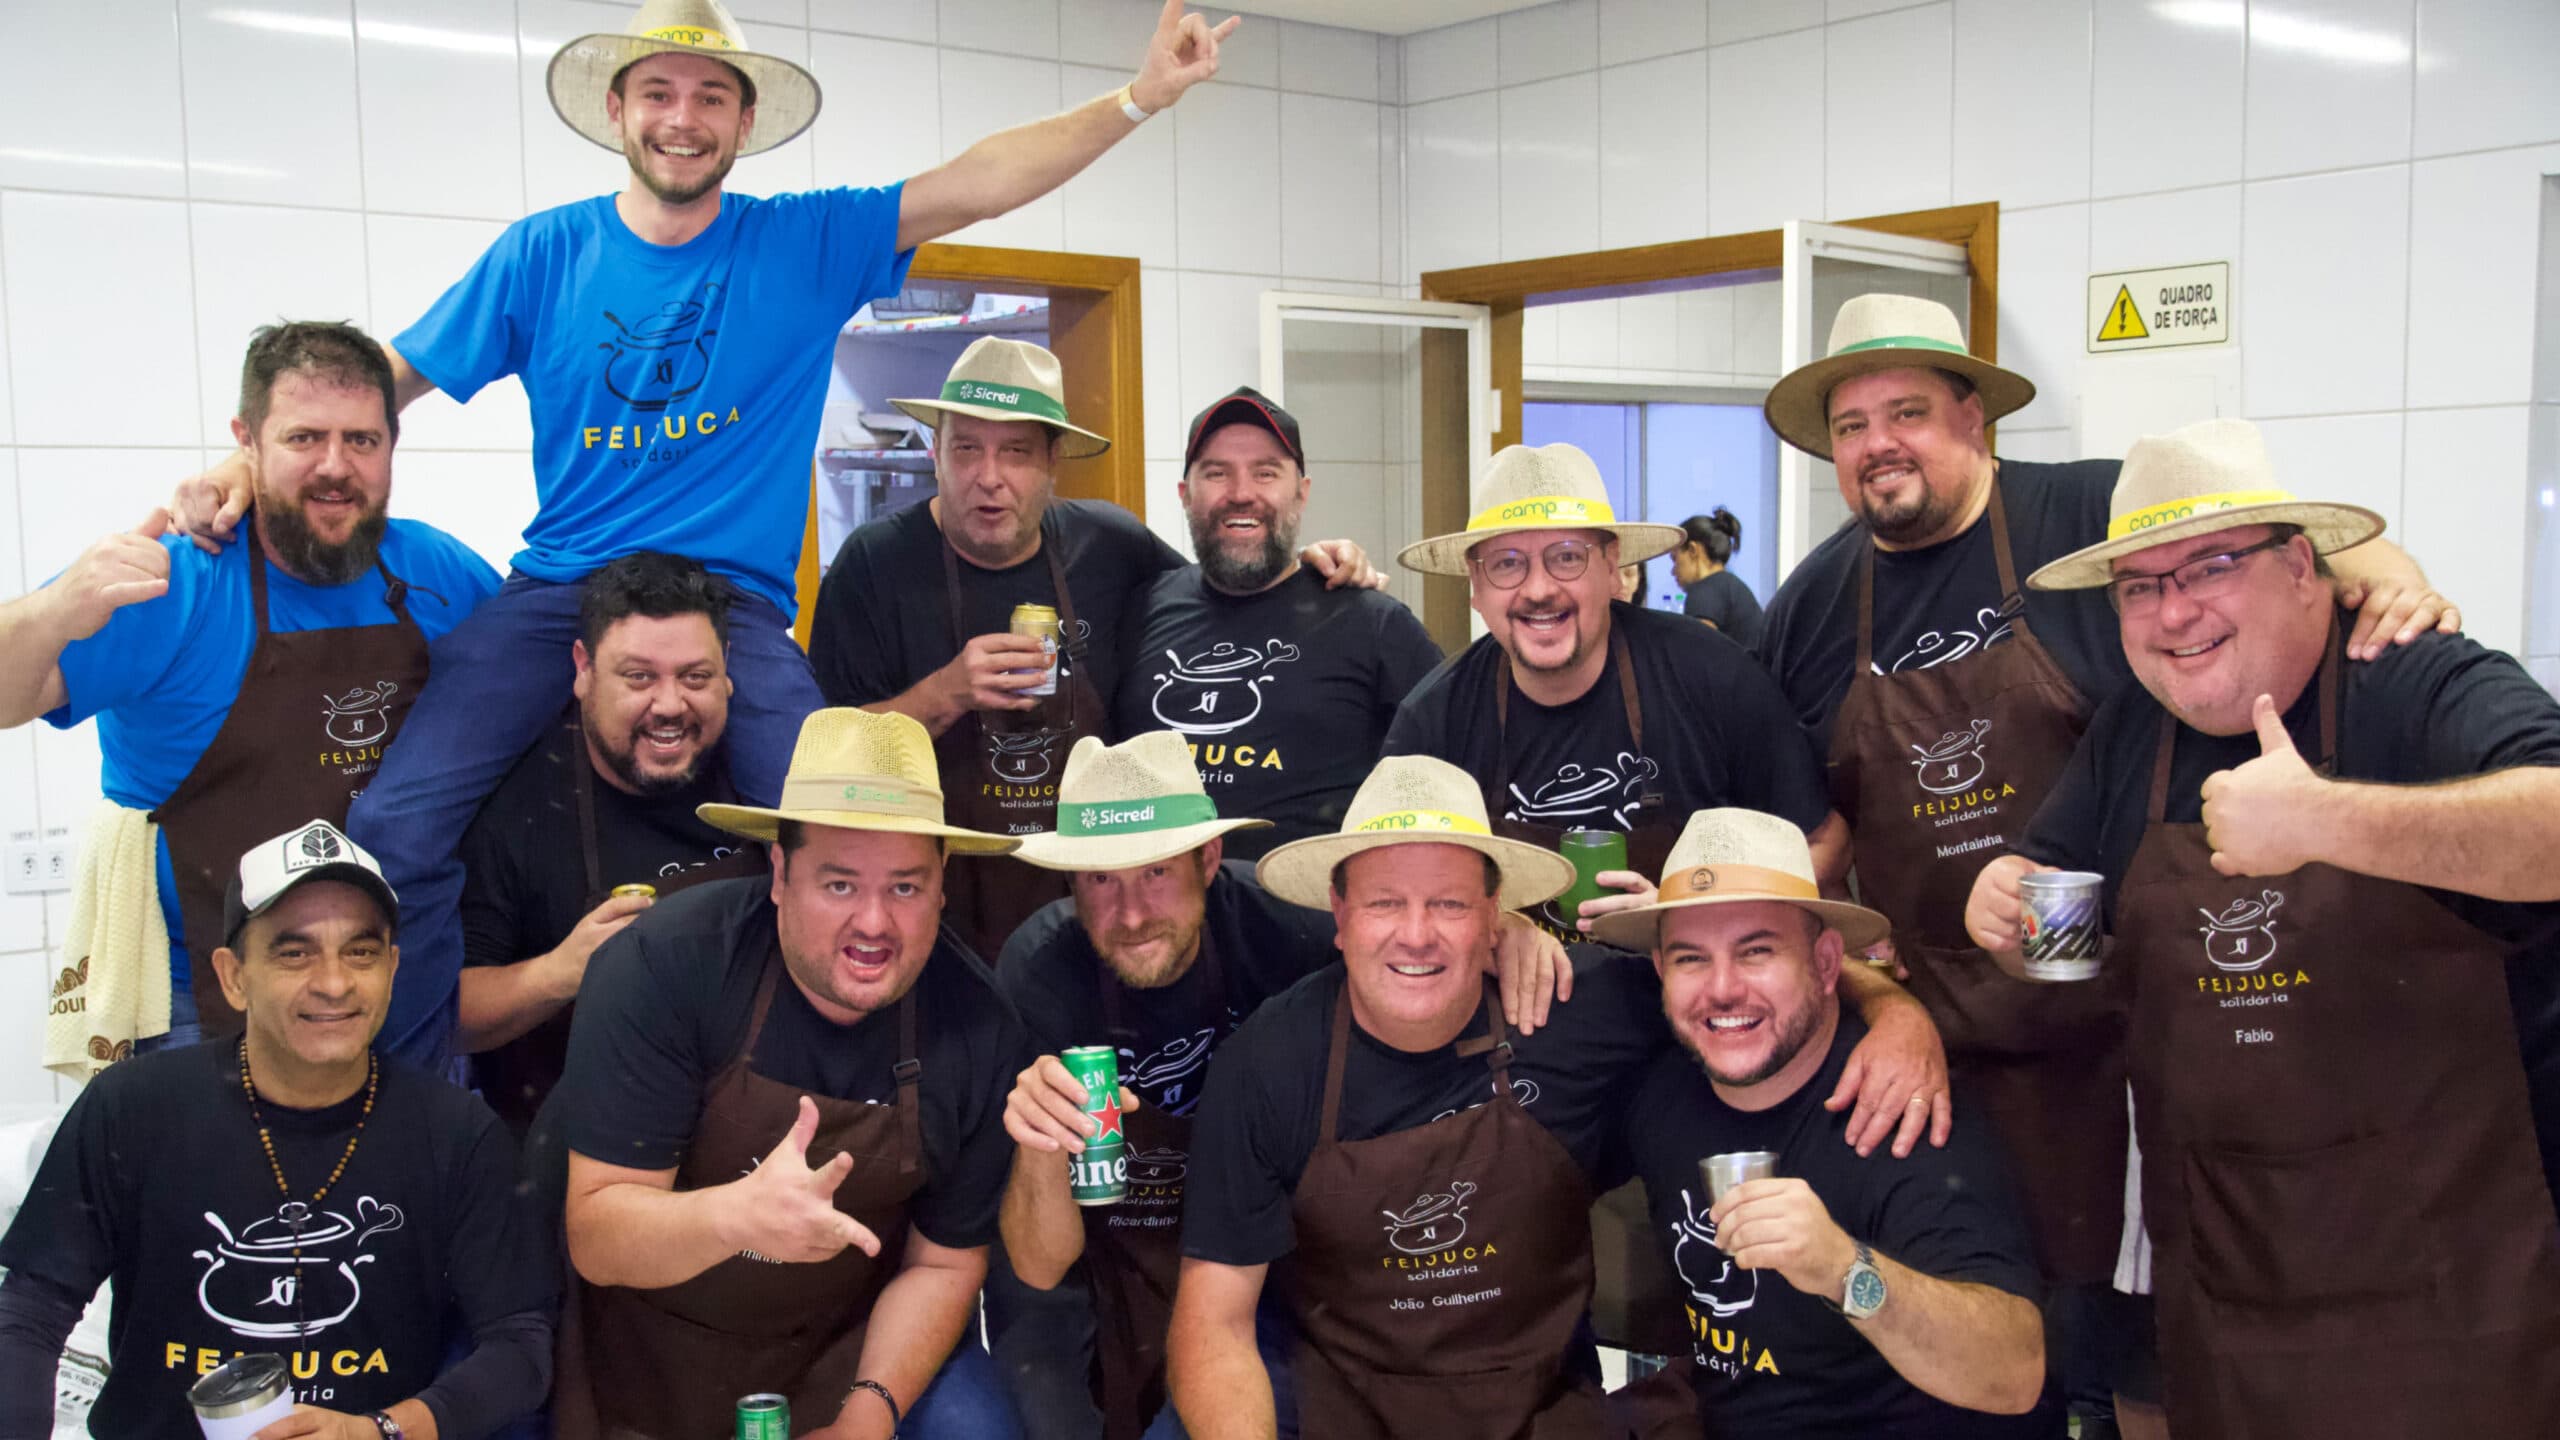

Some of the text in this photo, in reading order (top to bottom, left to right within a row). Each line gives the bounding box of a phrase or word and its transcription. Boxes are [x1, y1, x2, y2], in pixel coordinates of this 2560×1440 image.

[2159, 283, 2213, 305] QUADRO
[2154, 306, 2217, 331] DE FORÇA
[973, 387, 1020, 405] Sicredi
[583, 406, 740, 449] FEIUCA
[1502, 501, 1558, 521] camp
[983, 784, 1061, 798] FEIJUC
[1913, 783, 2016, 818] FEIJUCA
[1099, 805, 1155, 825] Sicredi
[1934, 805, 1998, 827] solidária
[1008, 822, 1043, 833] Xuxão
[1936, 834, 2004, 858] Montainha
[2198, 970, 2311, 993] FEIJUCA
[2219, 992, 2288, 1008] solidária
[2235, 1028, 2274, 1044] Fabio
[1383, 1243, 1497, 1268] FEIJUCA
[1407, 1265, 1478, 1281] solidária
[1389, 1287, 1502, 1310] João Guilherme
[165, 1342, 389, 1380] FEUCA
